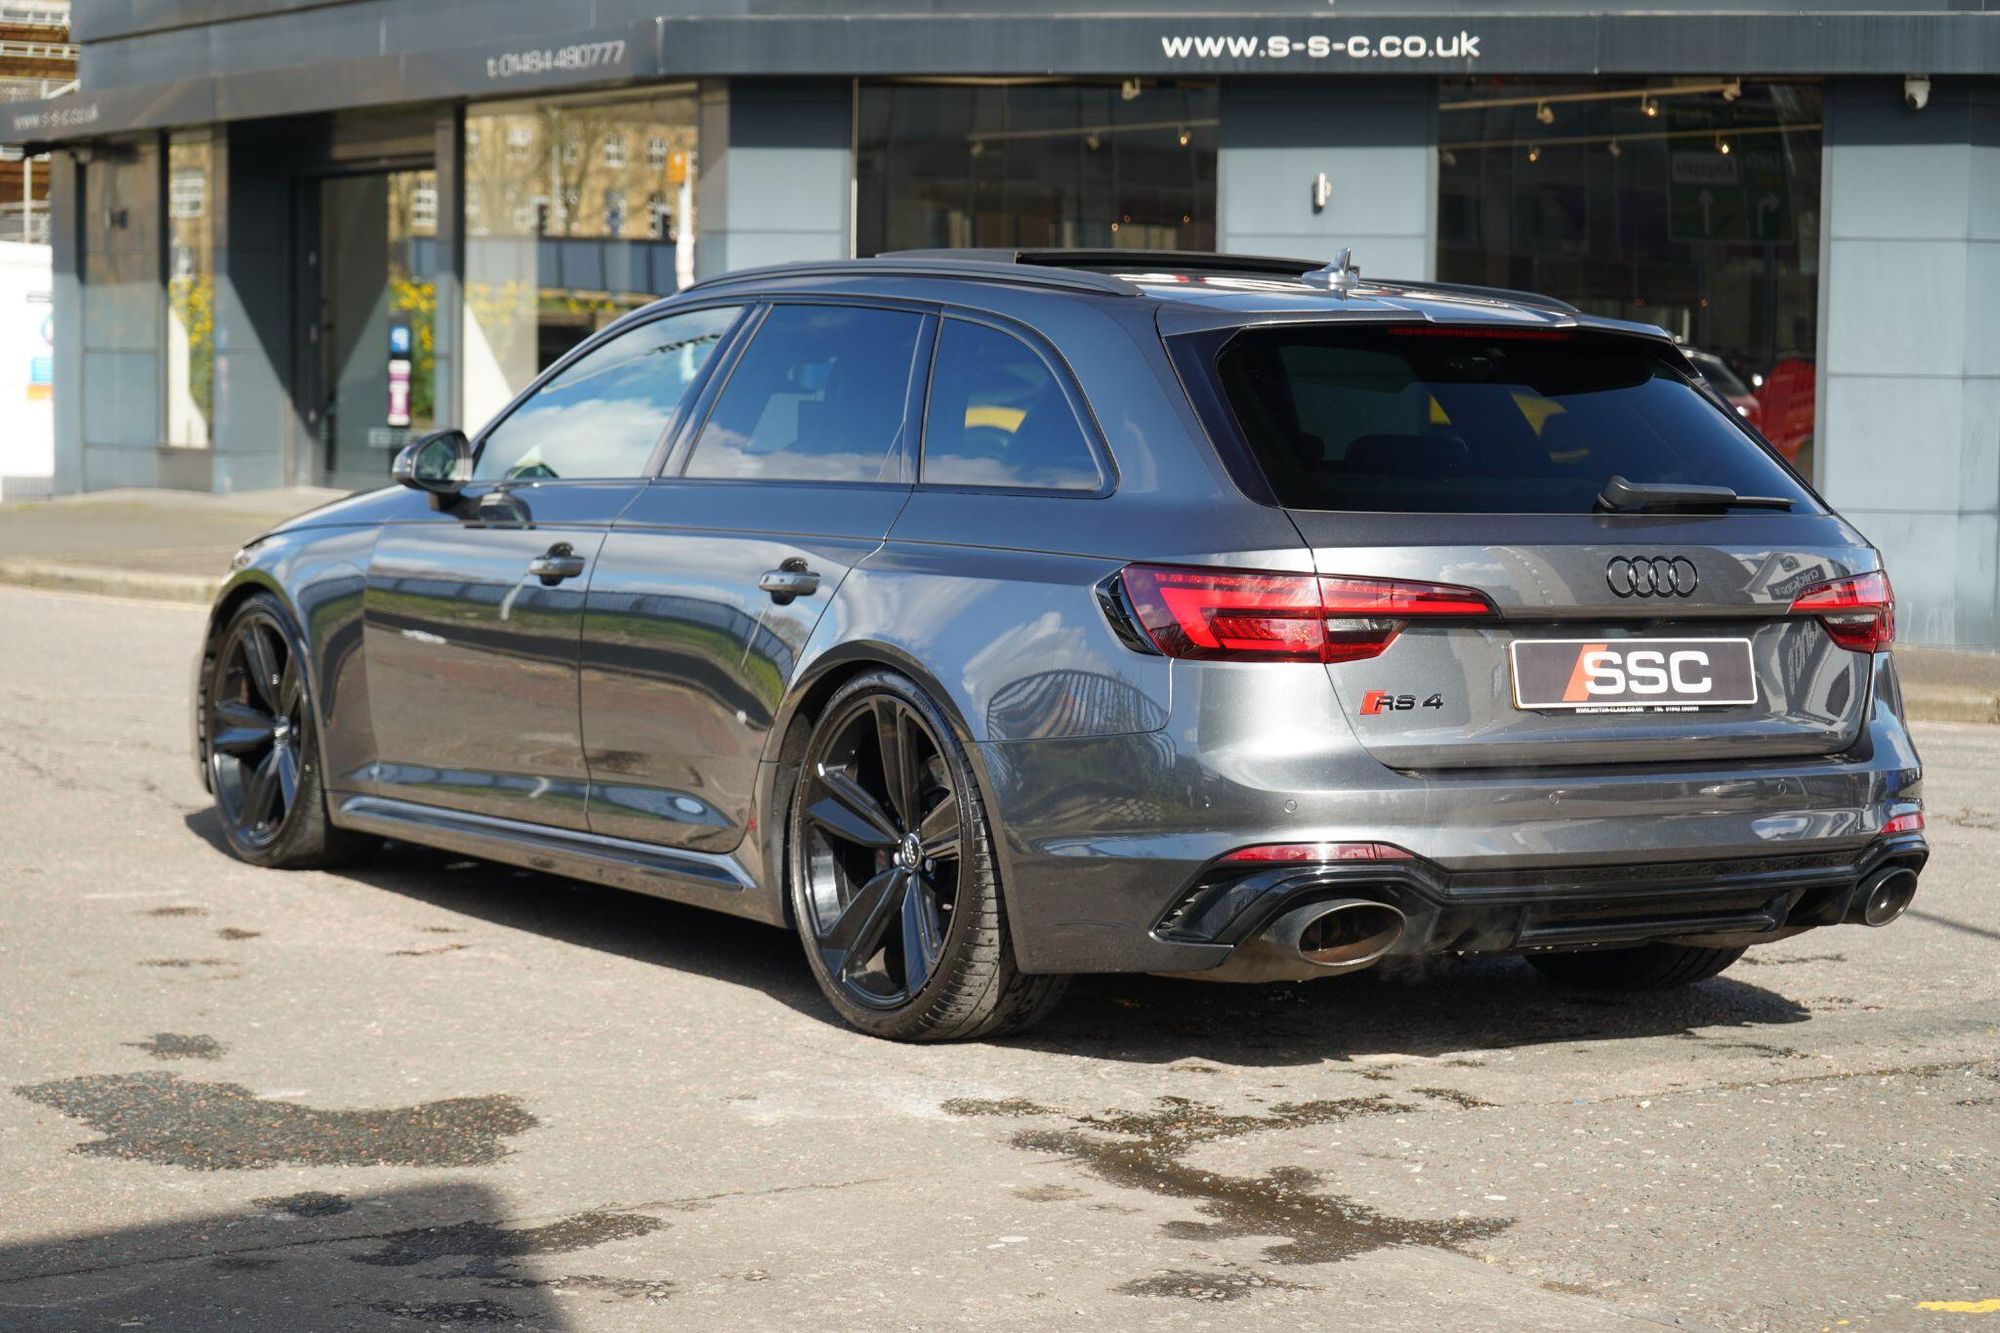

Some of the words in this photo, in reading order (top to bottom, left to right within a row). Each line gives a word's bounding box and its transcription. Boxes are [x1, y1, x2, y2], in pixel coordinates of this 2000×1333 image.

[1161, 31, 1481, 58] www.s-s-c.co.uk
[1583, 650, 1712, 695] SSC
[1372, 694, 1416, 711] RS
[1422, 693, 1444, 710] 4
